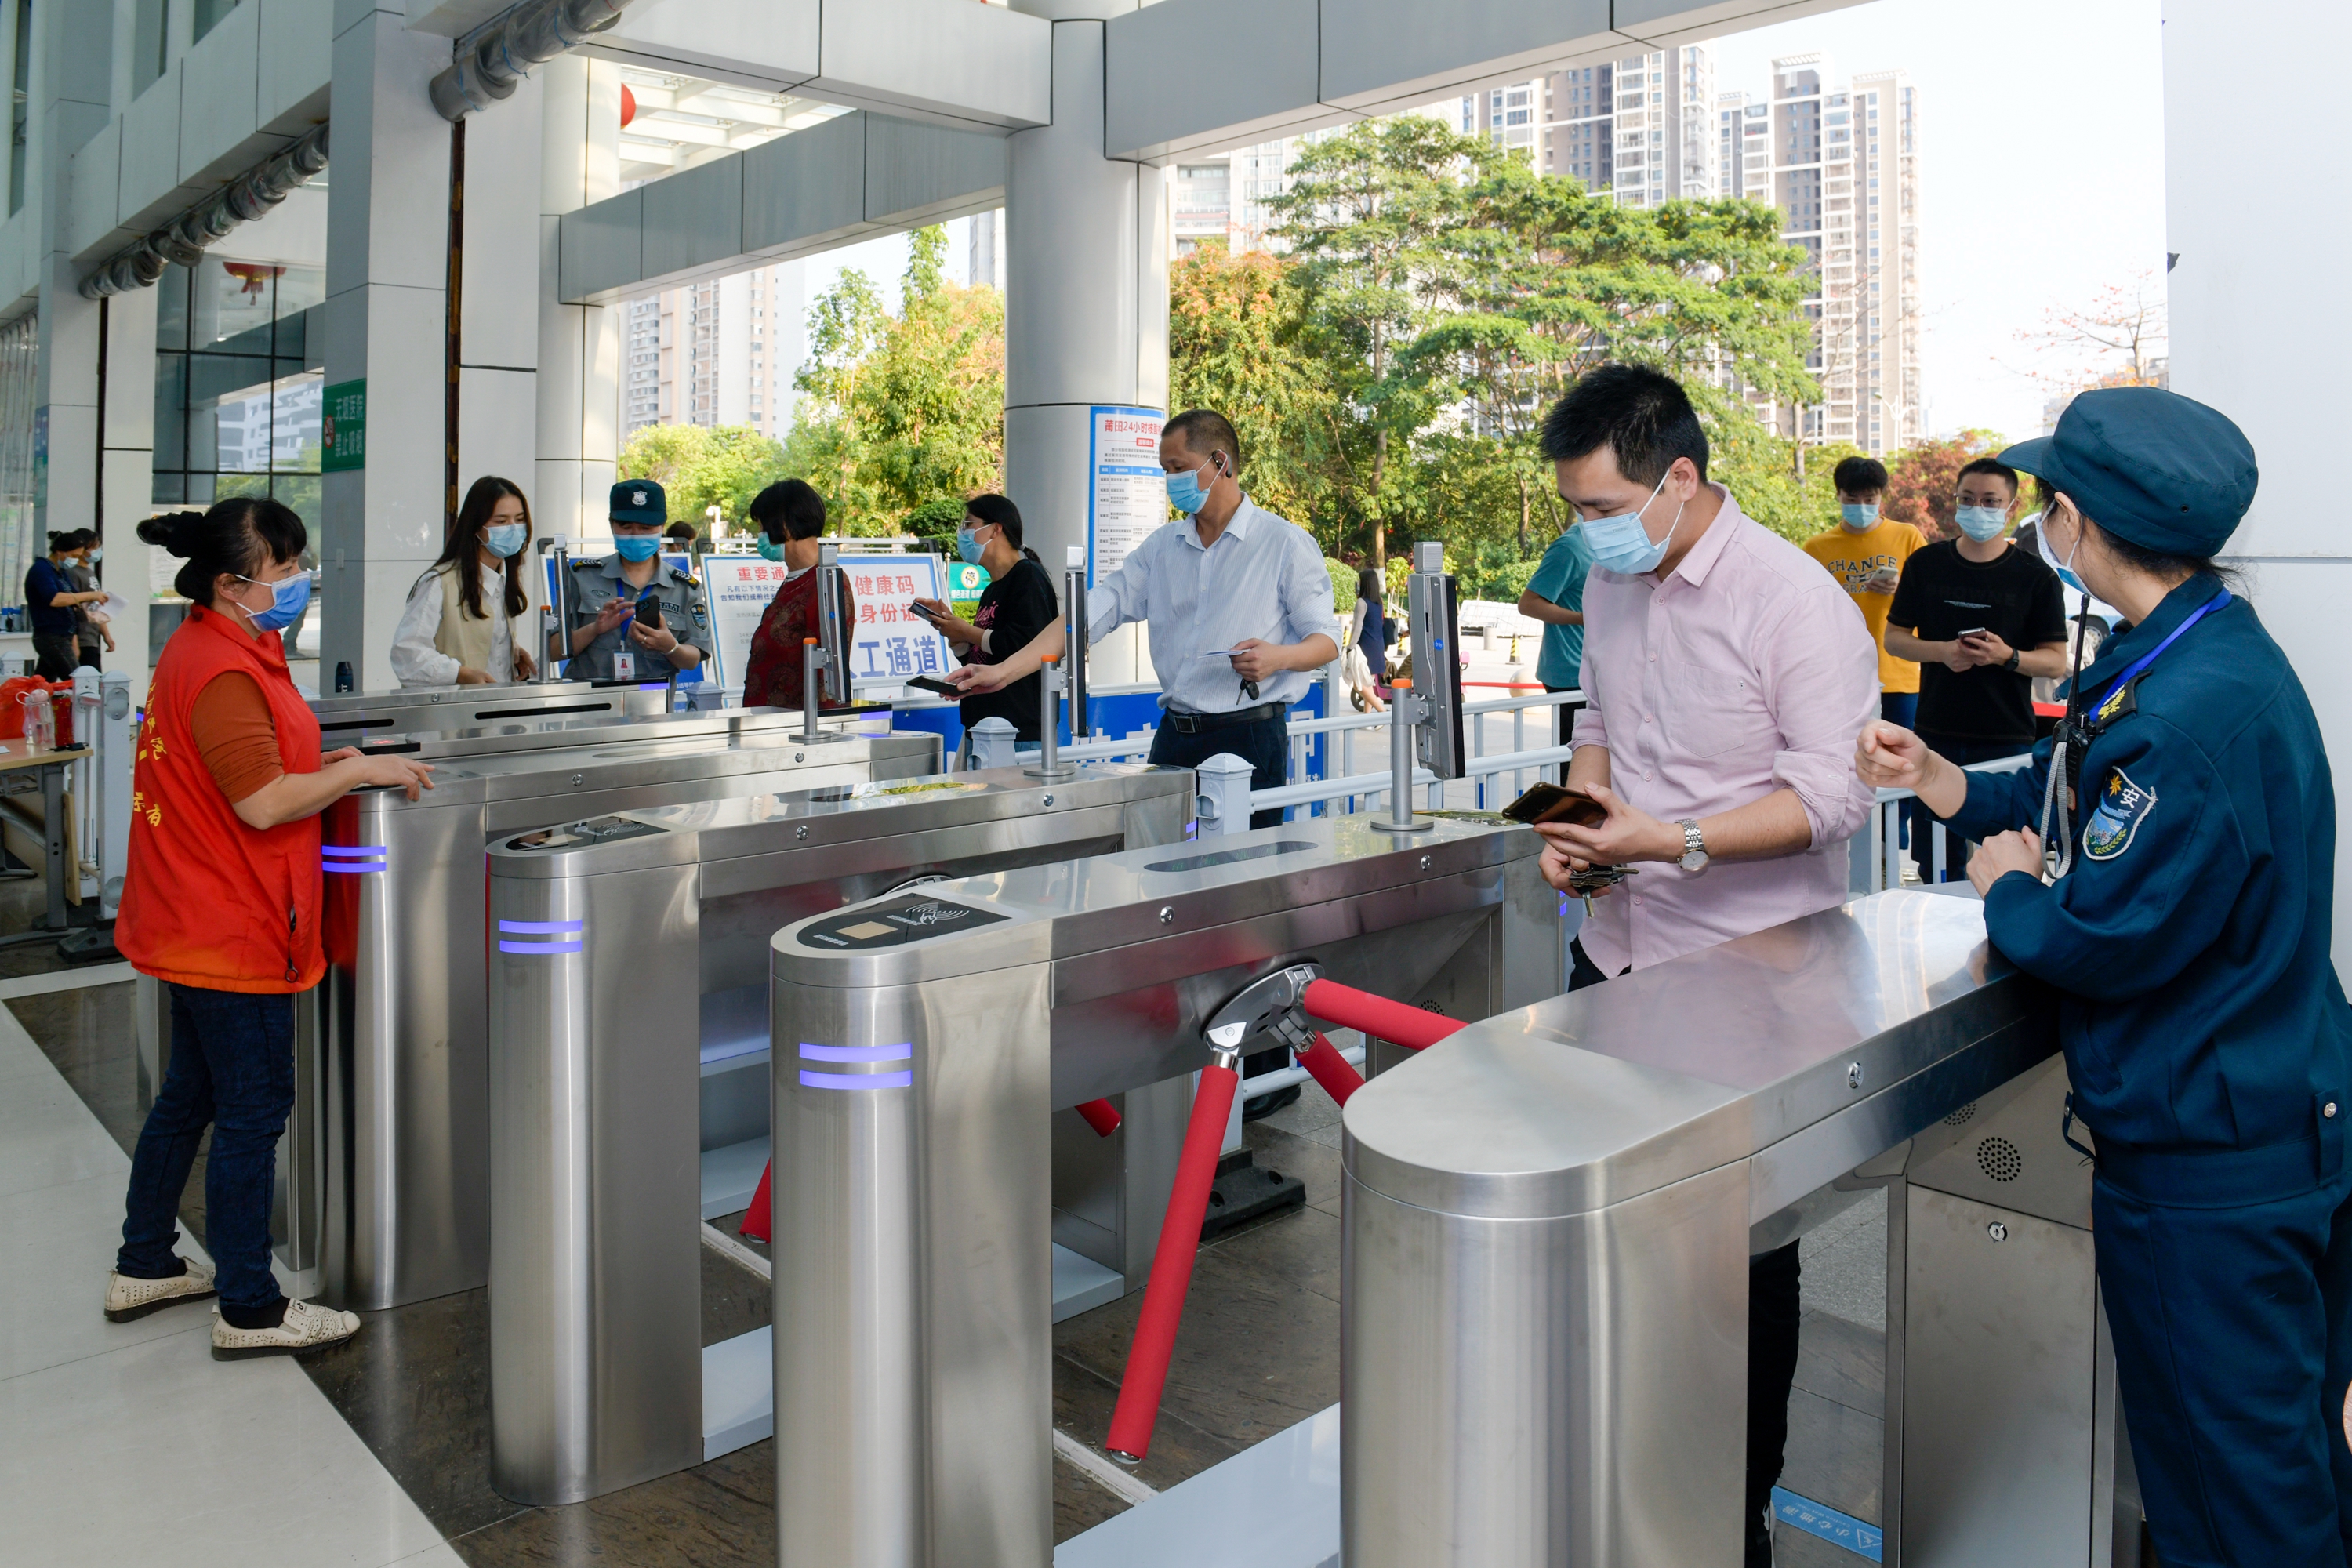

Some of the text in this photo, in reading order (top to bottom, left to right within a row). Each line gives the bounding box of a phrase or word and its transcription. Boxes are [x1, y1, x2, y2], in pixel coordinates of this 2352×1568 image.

[736, 566, 786, 581] 重要通
[1828, 555, 1897, 574] CHANCE
[854, 575, 915, 596] 健康码
[2119, 788, 2140, 809] 安
